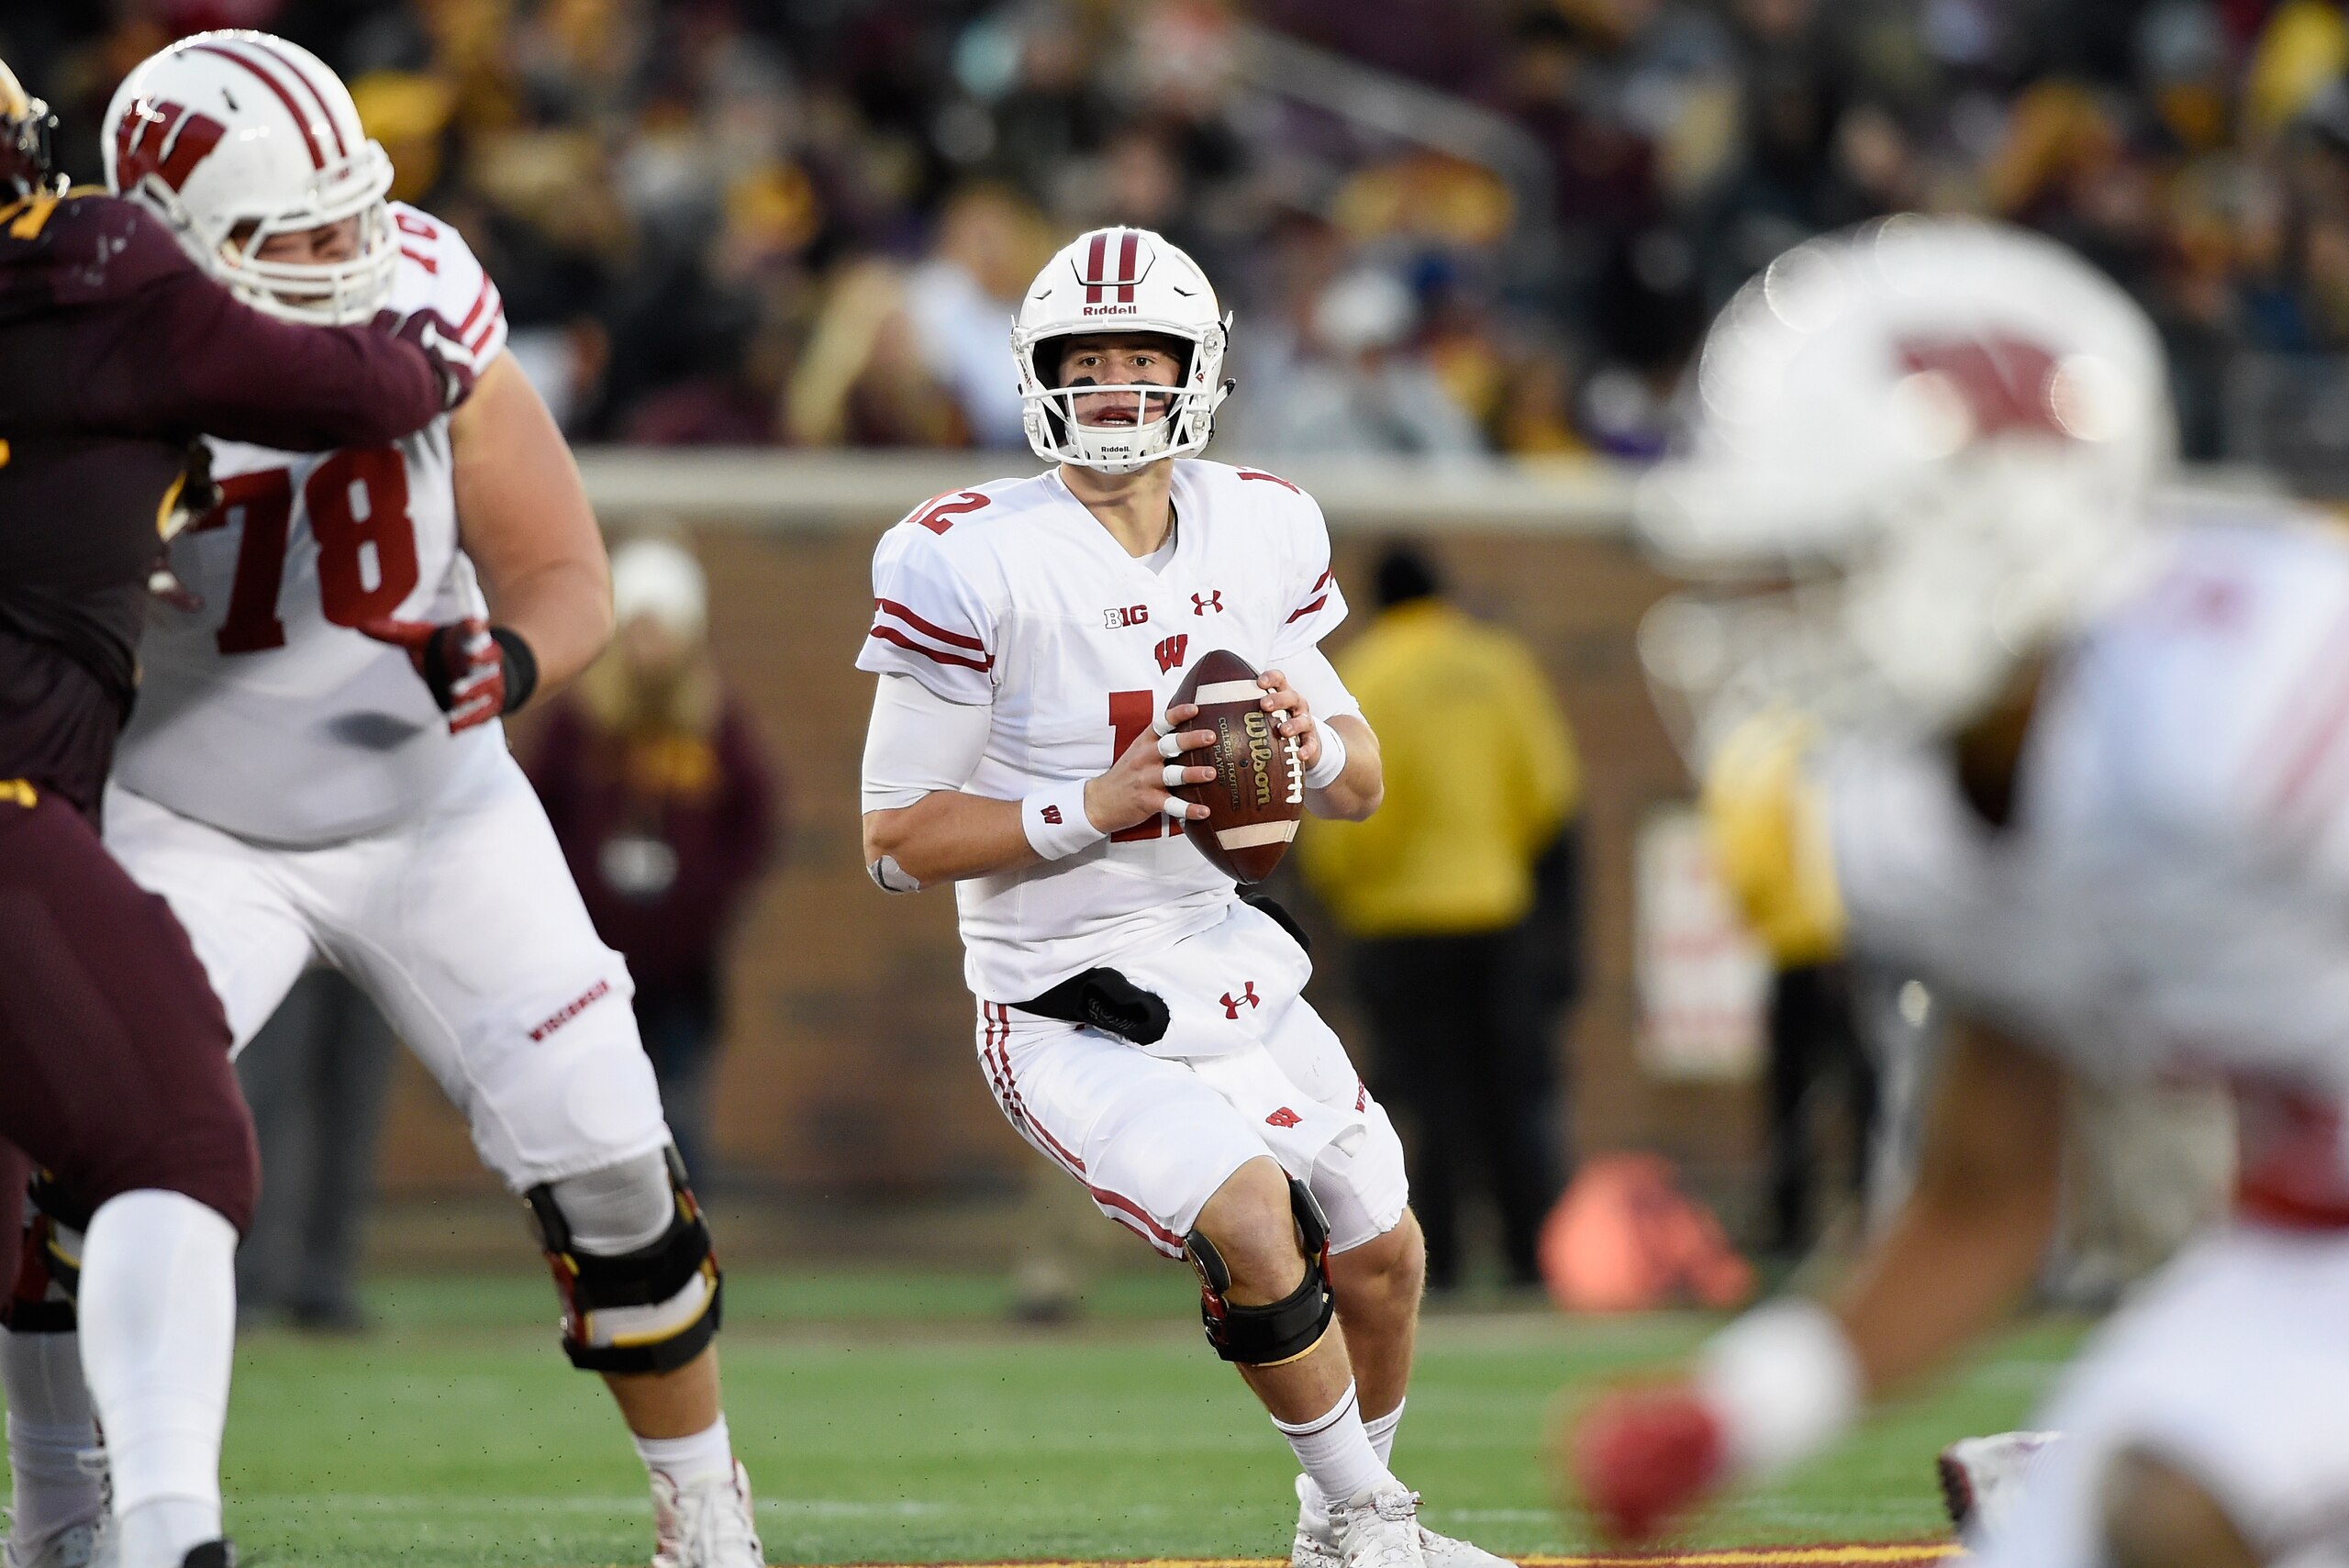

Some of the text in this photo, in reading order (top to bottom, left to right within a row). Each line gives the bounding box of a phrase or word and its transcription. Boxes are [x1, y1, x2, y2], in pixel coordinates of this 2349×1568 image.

[1084, 306, 1137, 316] Riddell
[189, 446, 420, 655] 78
[1154, 634, 1188, 676] W
[1218, 717, 1241, 812] COLLEGE FOOTBALL
[1243, 709, 1274, 806] Wilson
[1040, 804, 1063, 824] W
